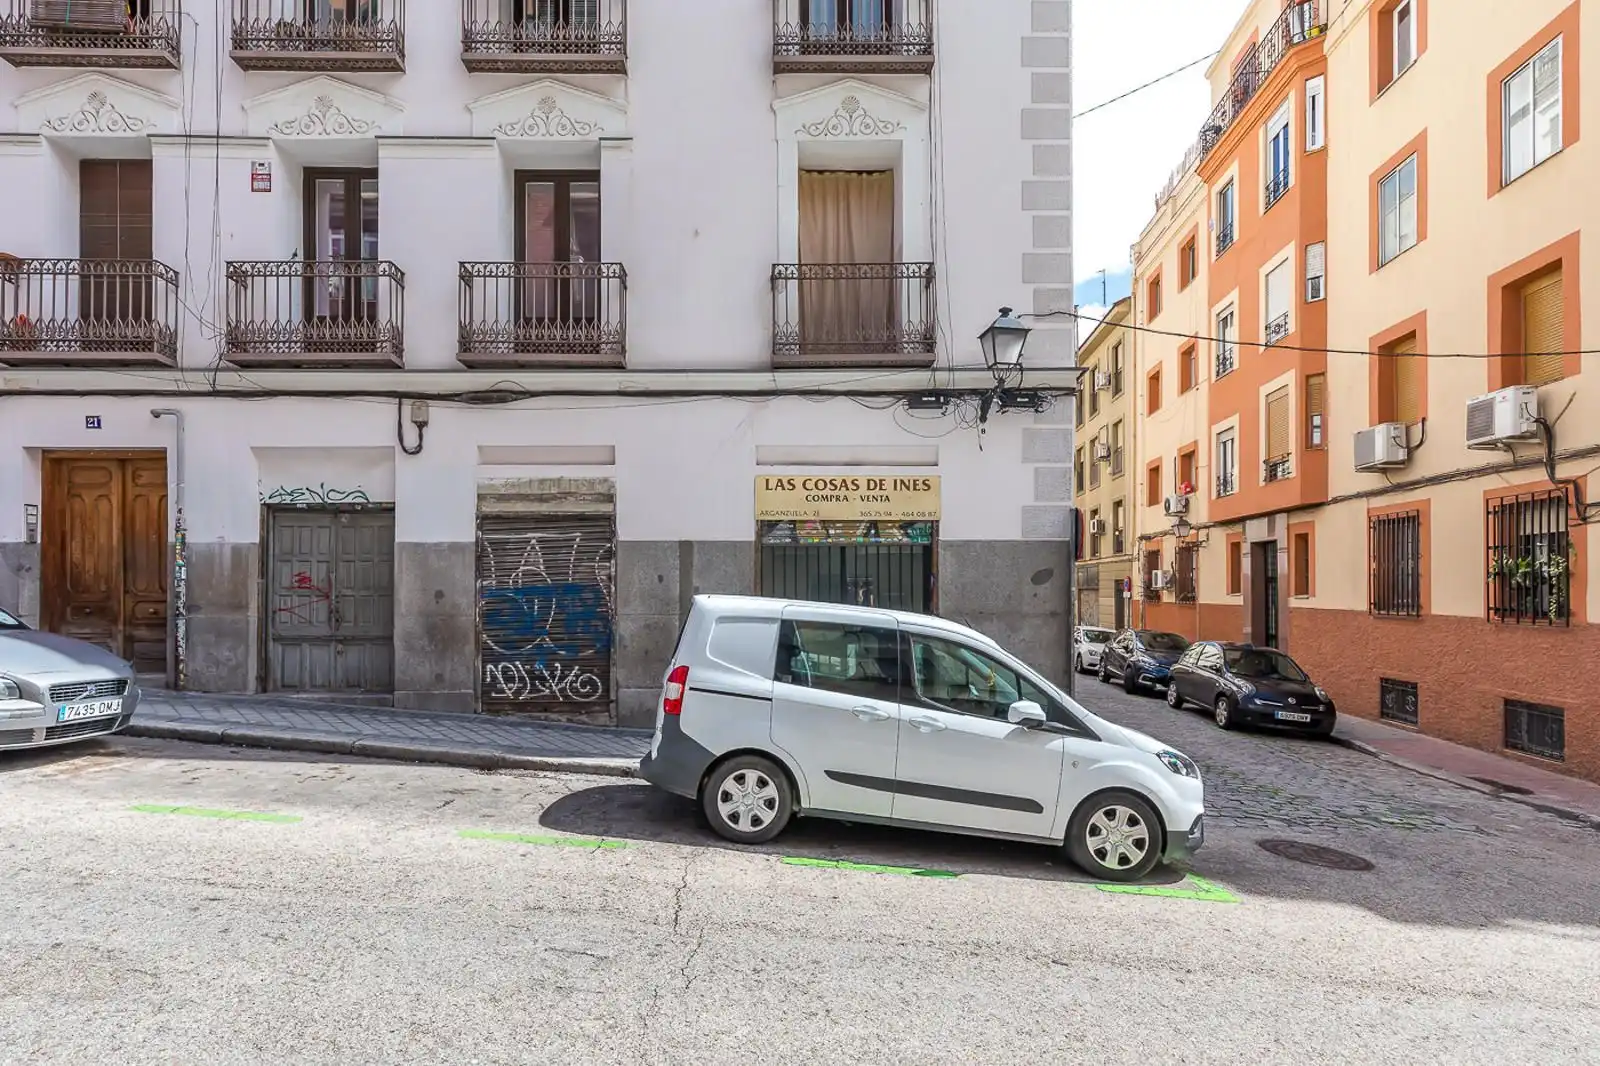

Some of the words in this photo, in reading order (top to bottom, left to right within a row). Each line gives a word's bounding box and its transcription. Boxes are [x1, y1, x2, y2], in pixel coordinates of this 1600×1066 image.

[87, 417, 98, 427] 21
[765, 478, 797, 491] LAS
[801, 478, 860, 491] COSAS
[866, 478, 888, 491] DE
[893, 478, 932, 491] INES
[805, 494, 849, 503] COMPRA
[860, 494, 891, 503] VENTA
[67, 704, 95, 718] 7435
[98, 701, 120, 713] DMJ
